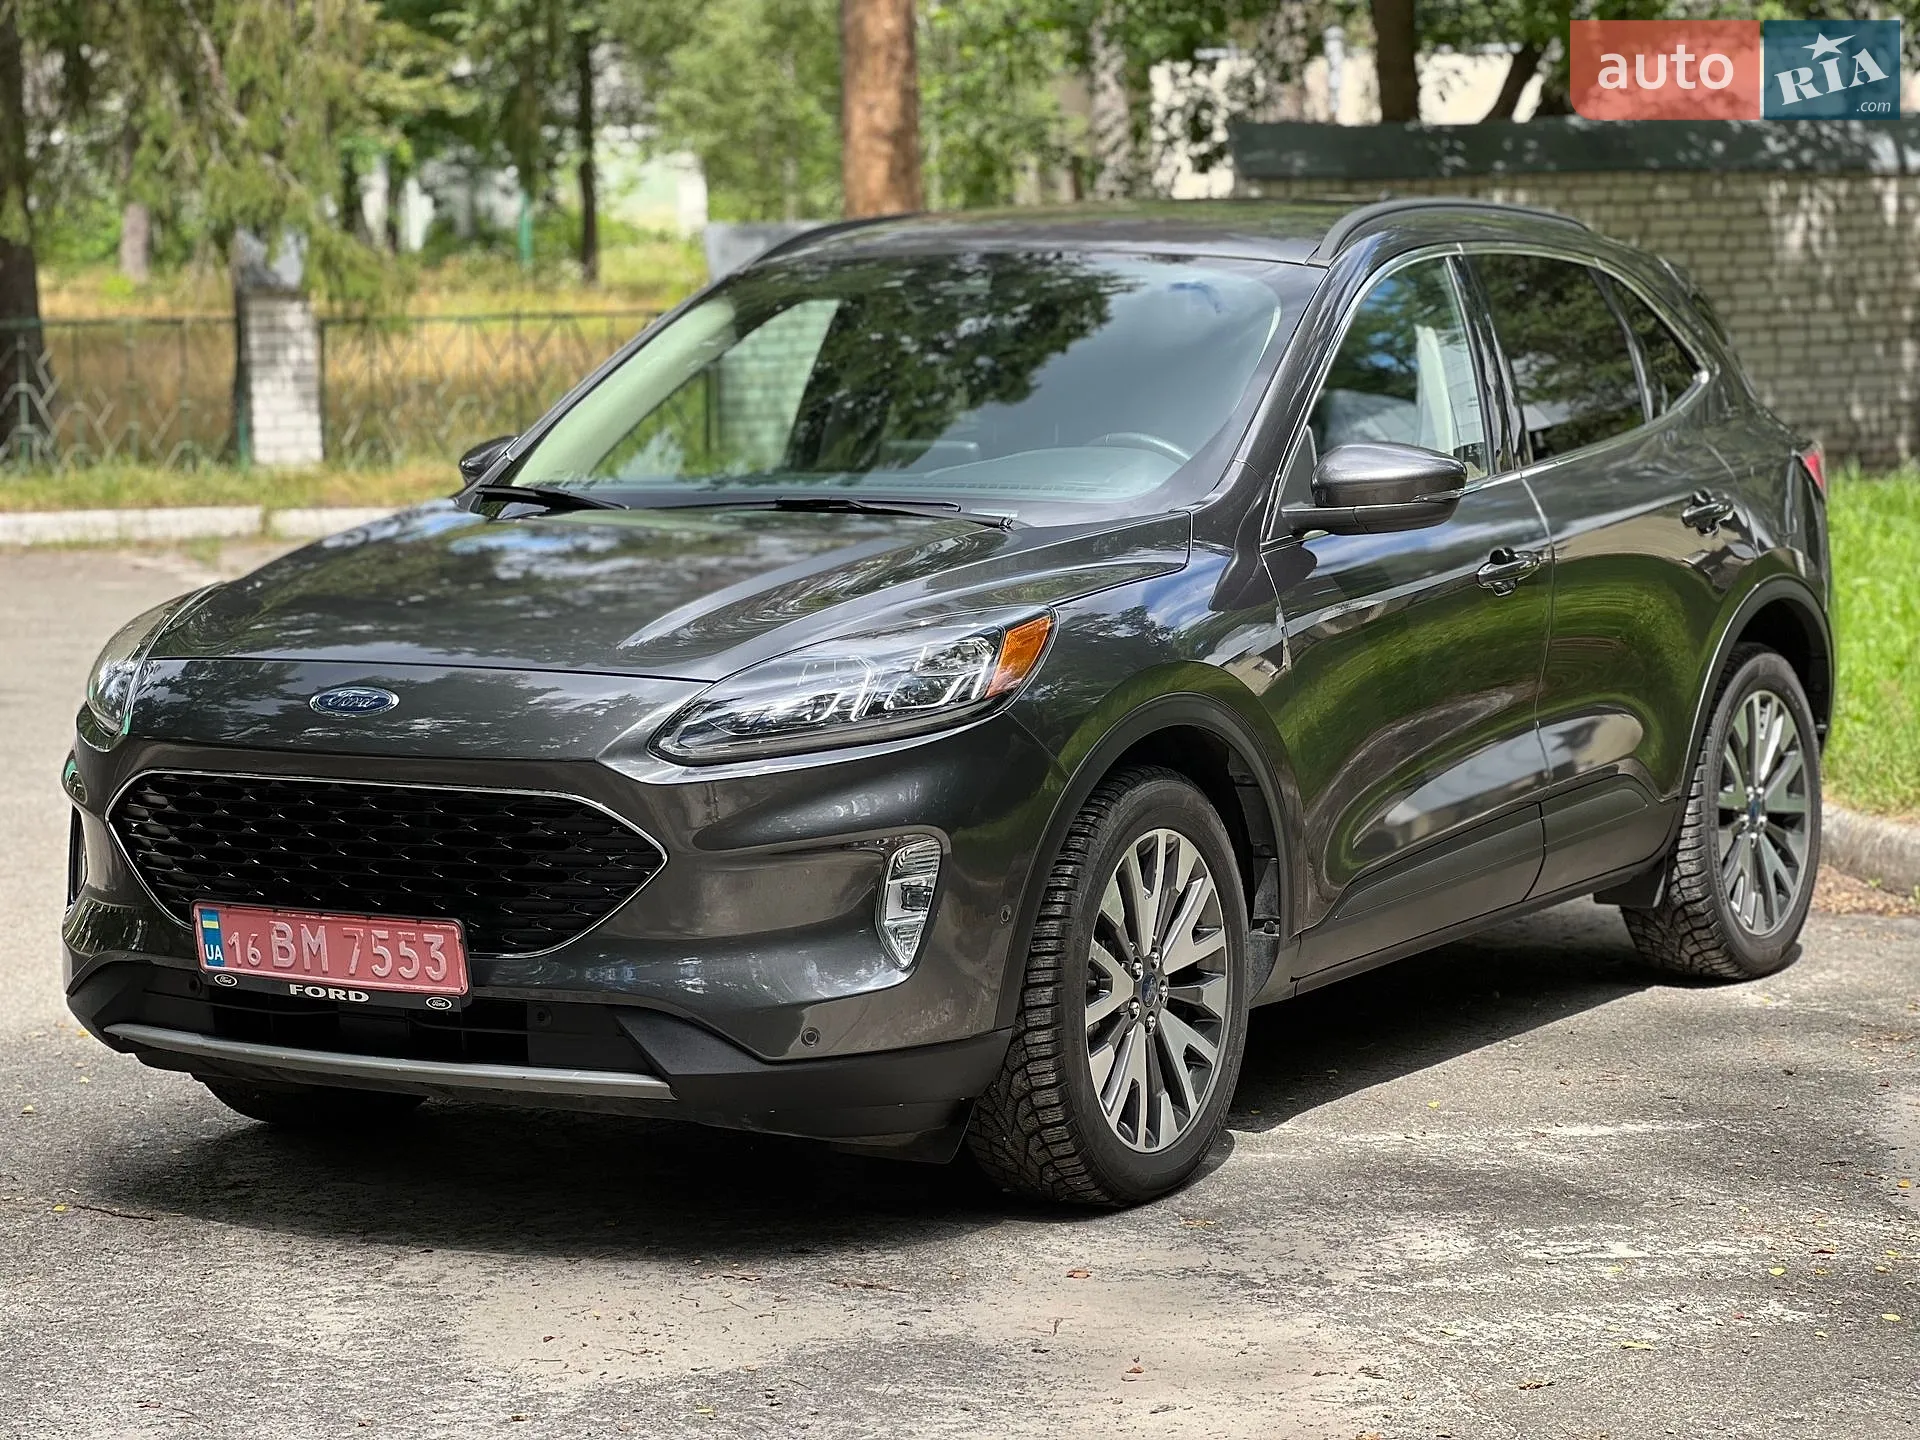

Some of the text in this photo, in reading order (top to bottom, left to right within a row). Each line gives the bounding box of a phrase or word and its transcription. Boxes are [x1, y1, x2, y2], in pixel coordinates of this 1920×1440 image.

[327, 689, 380, 708] Ford
[204, 943, 224, 962] UA
[227, 920, 448, 982] 16 BM 7553
[289, 983, 370, 1003] FORD
